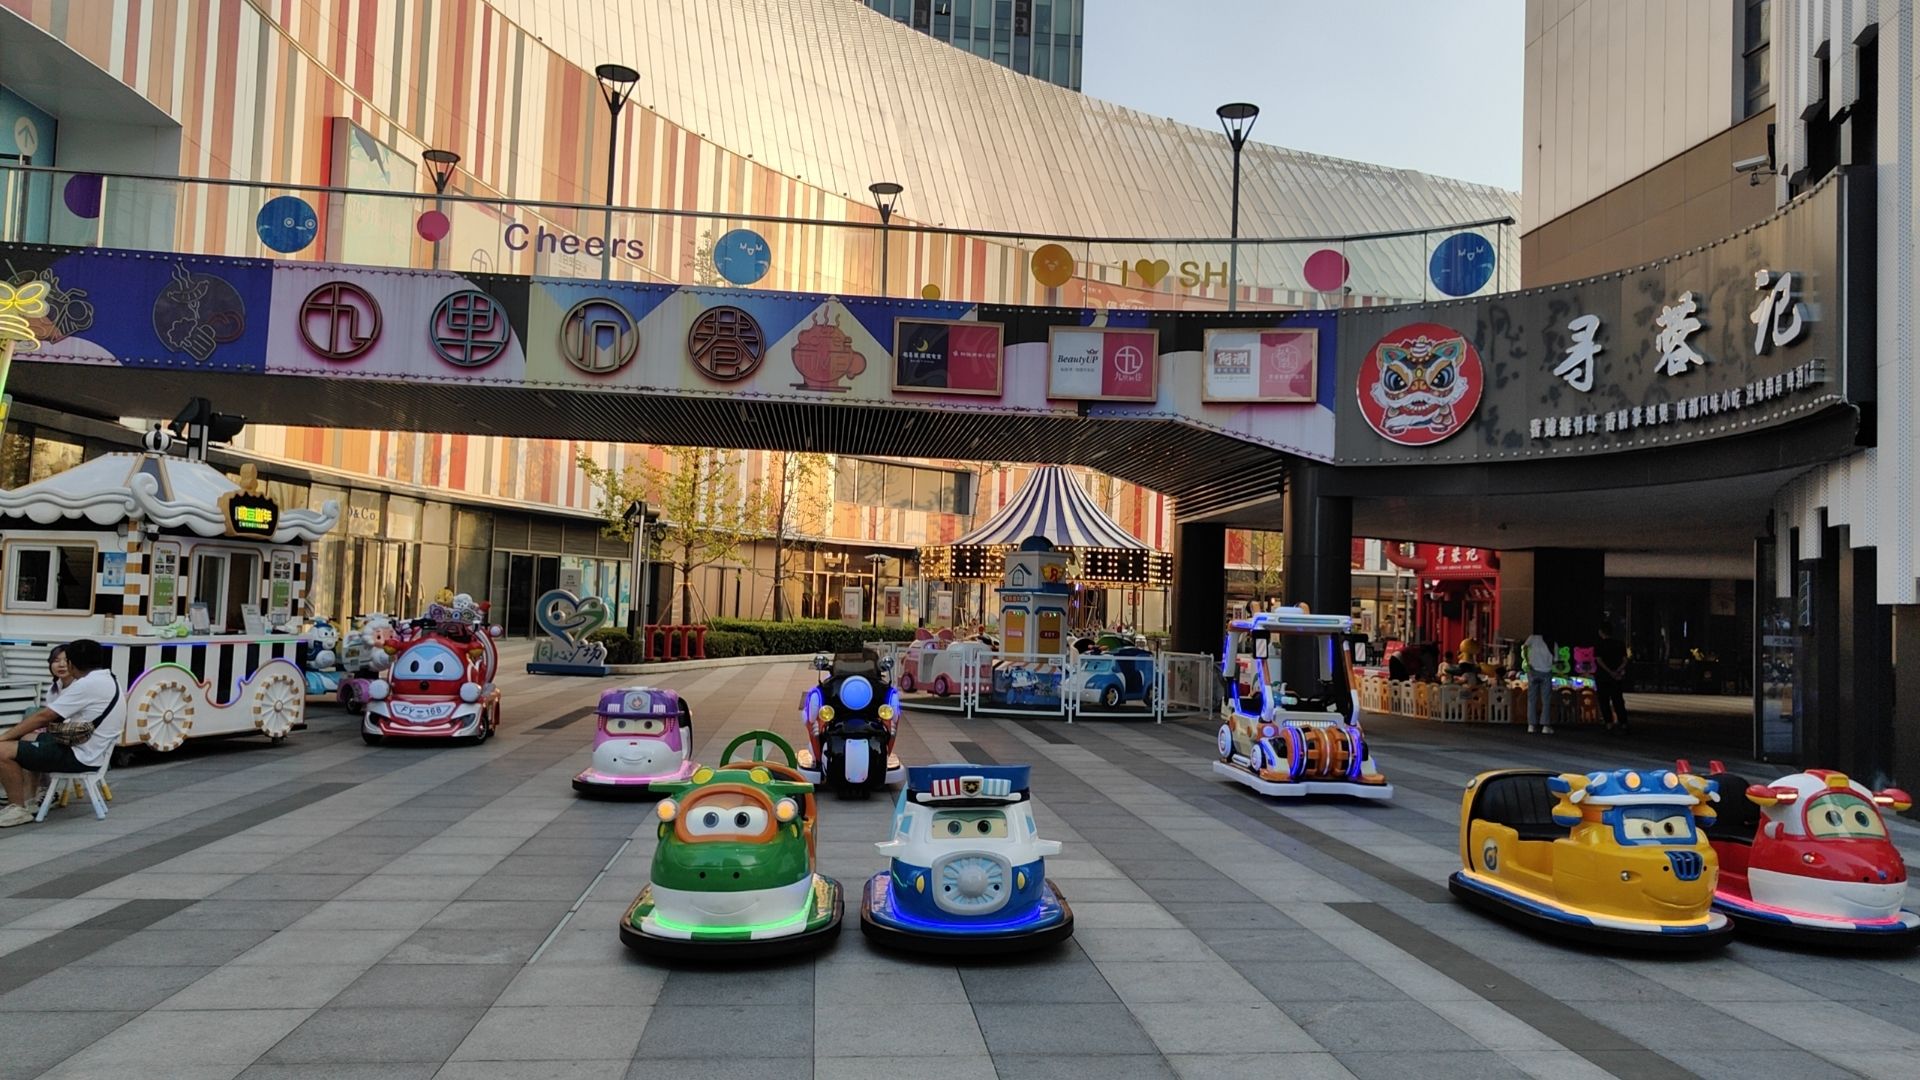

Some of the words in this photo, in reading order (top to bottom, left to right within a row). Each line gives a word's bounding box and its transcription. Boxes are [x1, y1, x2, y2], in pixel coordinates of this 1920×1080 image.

[504, 223, 644, 260] Cheers
[1179, 261, 1227, 288] SH
[1057, 355, 1099, 366] BeautyUP
